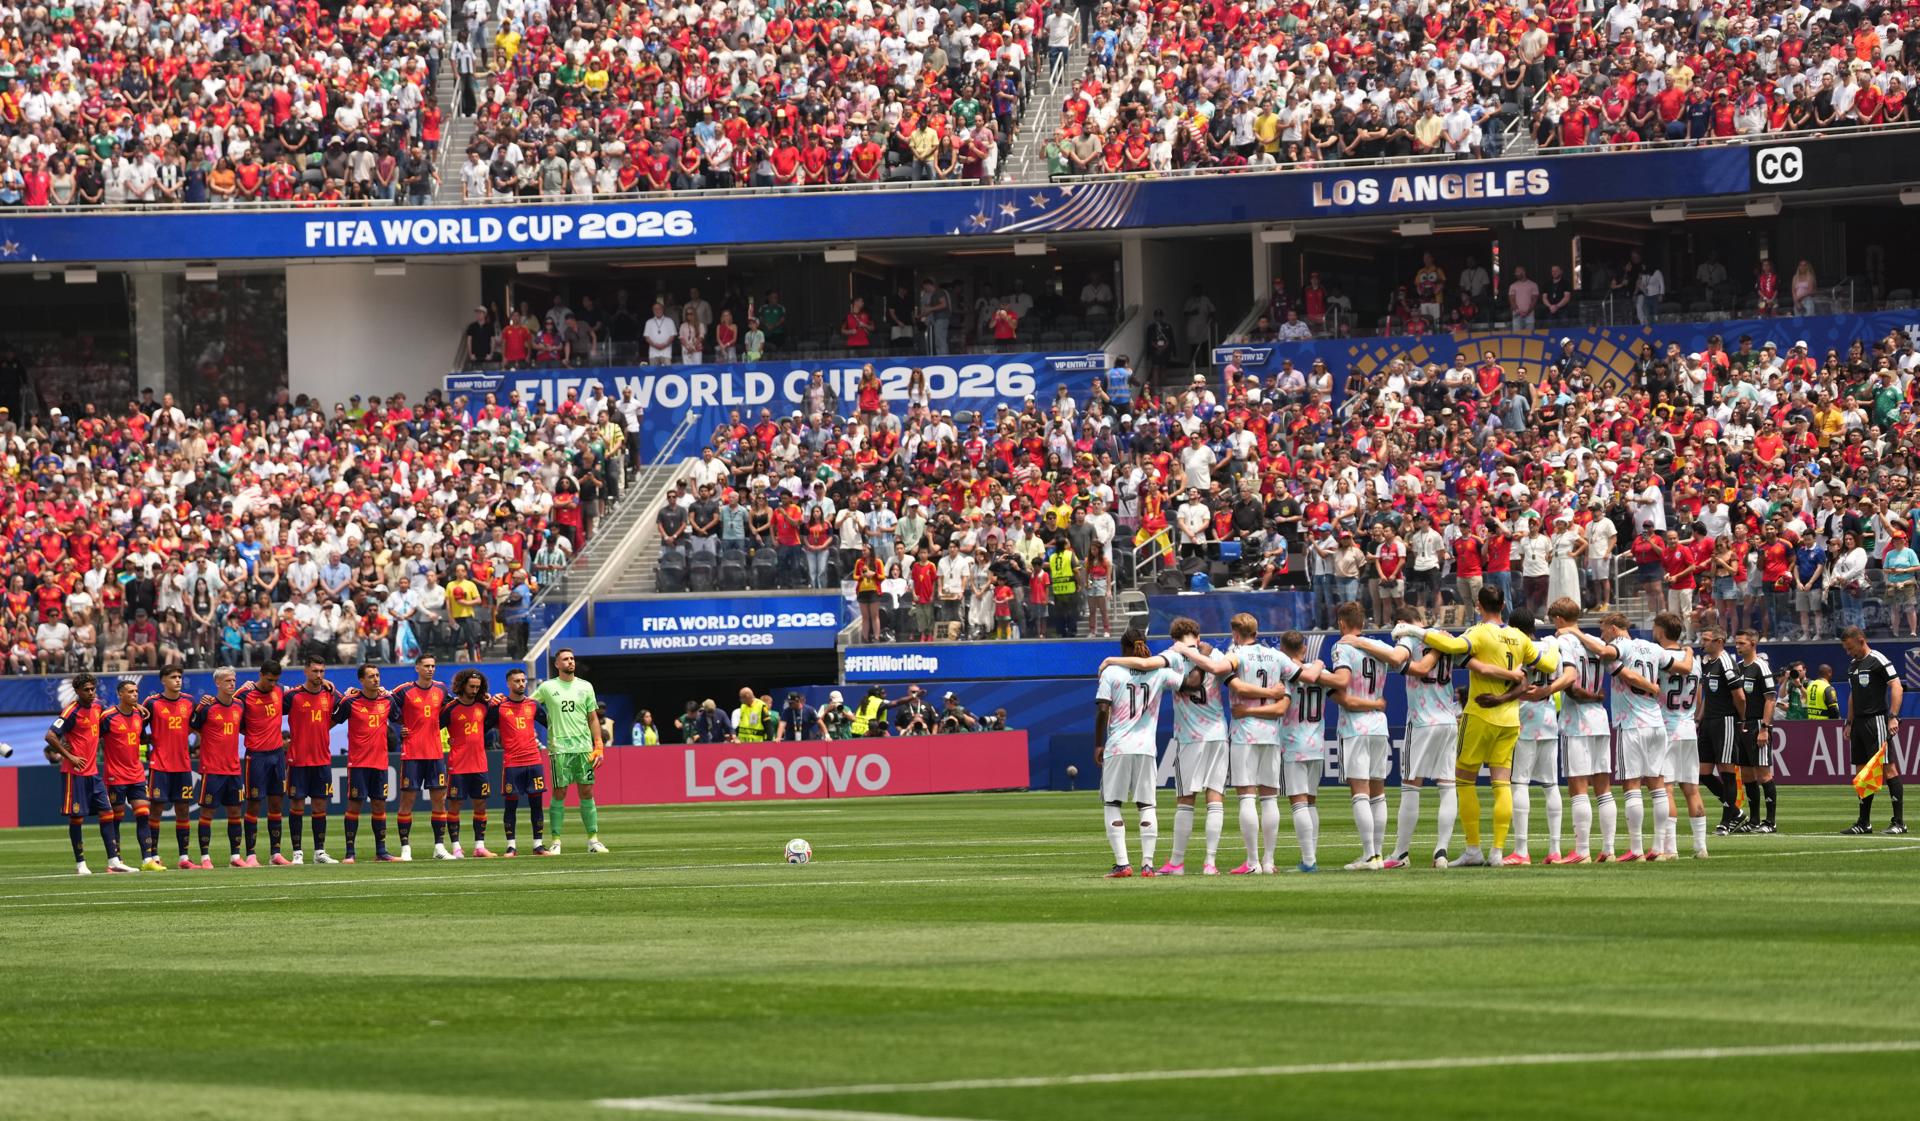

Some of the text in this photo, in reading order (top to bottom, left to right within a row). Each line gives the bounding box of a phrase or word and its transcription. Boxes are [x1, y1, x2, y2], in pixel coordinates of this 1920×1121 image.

[1761, 152, 1798, 180] CC
[1313, 168, 1550, 207] LOS ANGELES
[305, 210, 694, 248] FIFA WORLD CUP 2026
[614, 372, 775, 409] WORLD
[878, 362, 1036, 401] 2026
[643, 612, 836, 632] FIFA WORLD CUP 2026
[620, 633, 774, 650] FIFA WORLD CUP 2026
[844, 654, 938, 673] #FIFAWorldCup
[1580, 656, 1601, 694] 17
[1126, 683, 1150, 719] 11
[1667, 675, 1698, 710] 23
[424, 705, 431, 718] 8
[561, 700, 575, 713] 23
[1297, 687, 1321, 723] 10
[168, 716, 182, 729] 22
[311, 710, 322, 722] 14
[368, 714, 380, 728] 21
[515, 717, 526, 729] 15
[223, 722, 234, 735] 10
[464, 722, 479, 735] 24
[127, 732, 137, 745] 12
[438, 773, 445, 786] 8
[685, 749, 891, 797] Lenovo
[533, 776, 544, 790] 15
